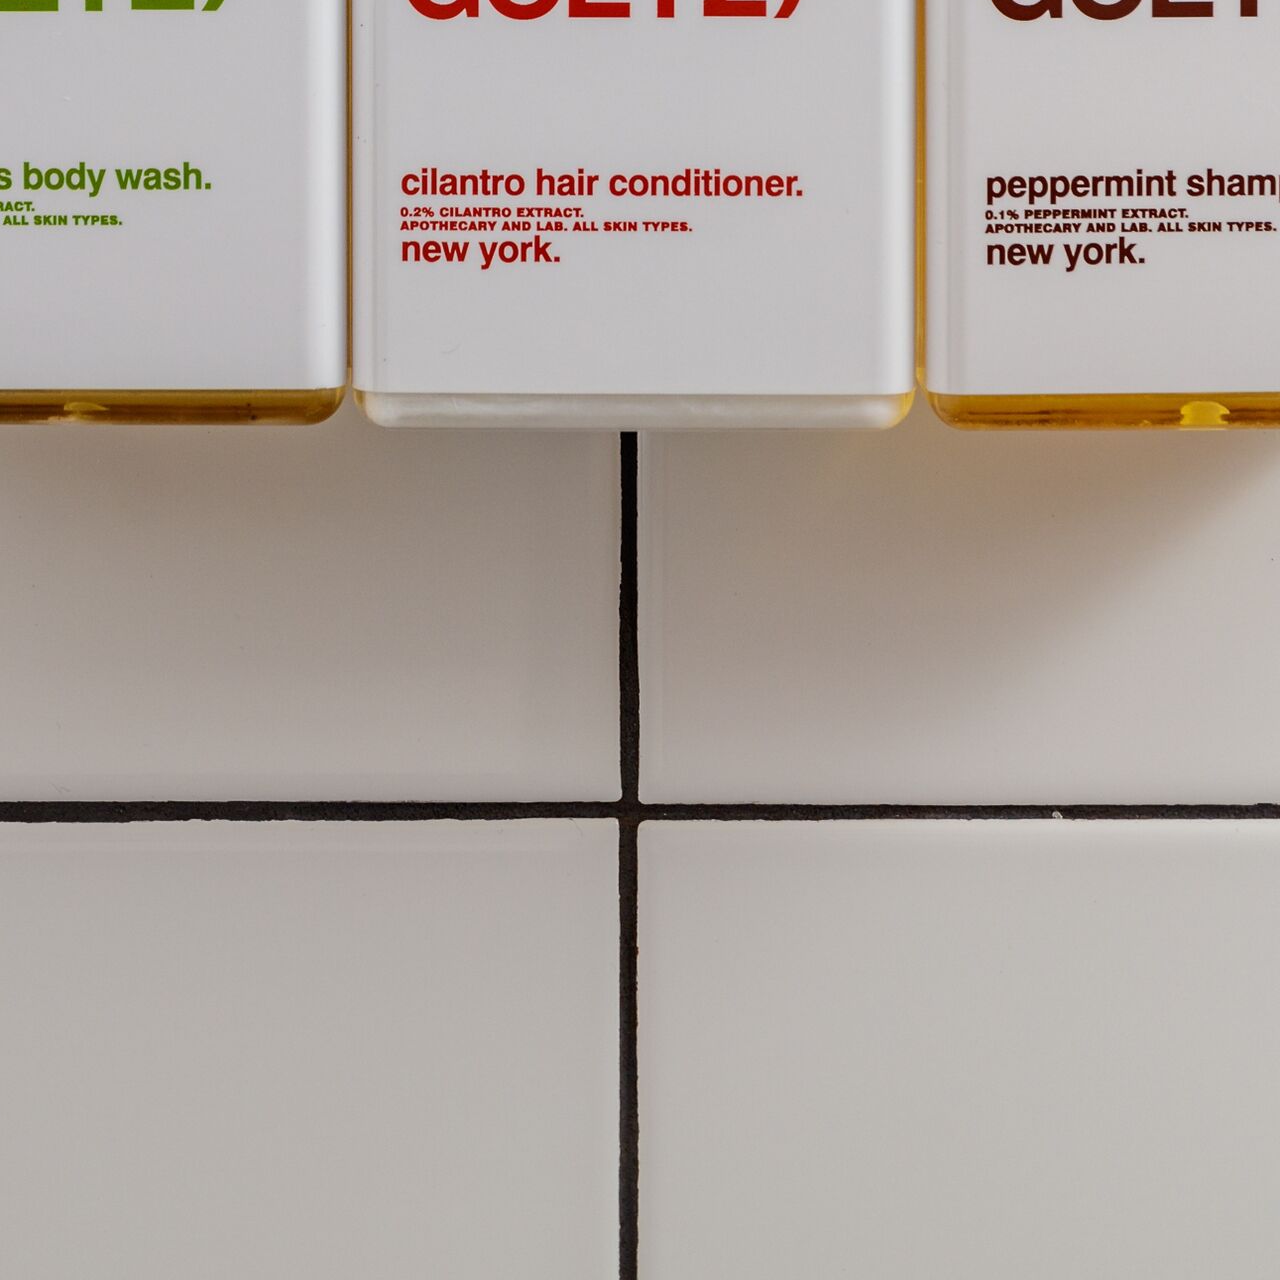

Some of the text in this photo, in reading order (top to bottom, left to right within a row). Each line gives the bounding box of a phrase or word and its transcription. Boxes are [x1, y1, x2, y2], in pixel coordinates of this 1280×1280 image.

[23, 162, 105, 198] body
[115, 162, 213, 191] wash.
[401, 167, 804, 198] cilantro hair conditioner.
[986, 169, 1177, 205] peppermint
[2, 215, 29, 226] ALL
[33, 215, 68, 226] SKIN
[72, 215, 123, 226] TYPES.
[400, 207, 584, 218] 0.2% CILANTRO EXTRACT.
[985, 208, 1189, 220] 0.1% PEPPERMINT EXTRACT.
[400, 220, 693, 232] APOTHECARY AND LAB. ALL SKIN TYPES.
[985, 221, 1277, 233] APOTHECARY AND LAB. ALL SKIN TYPES.
[401, 234, 561, 271] new york.
[986, 237, 1146, 272] new york.
